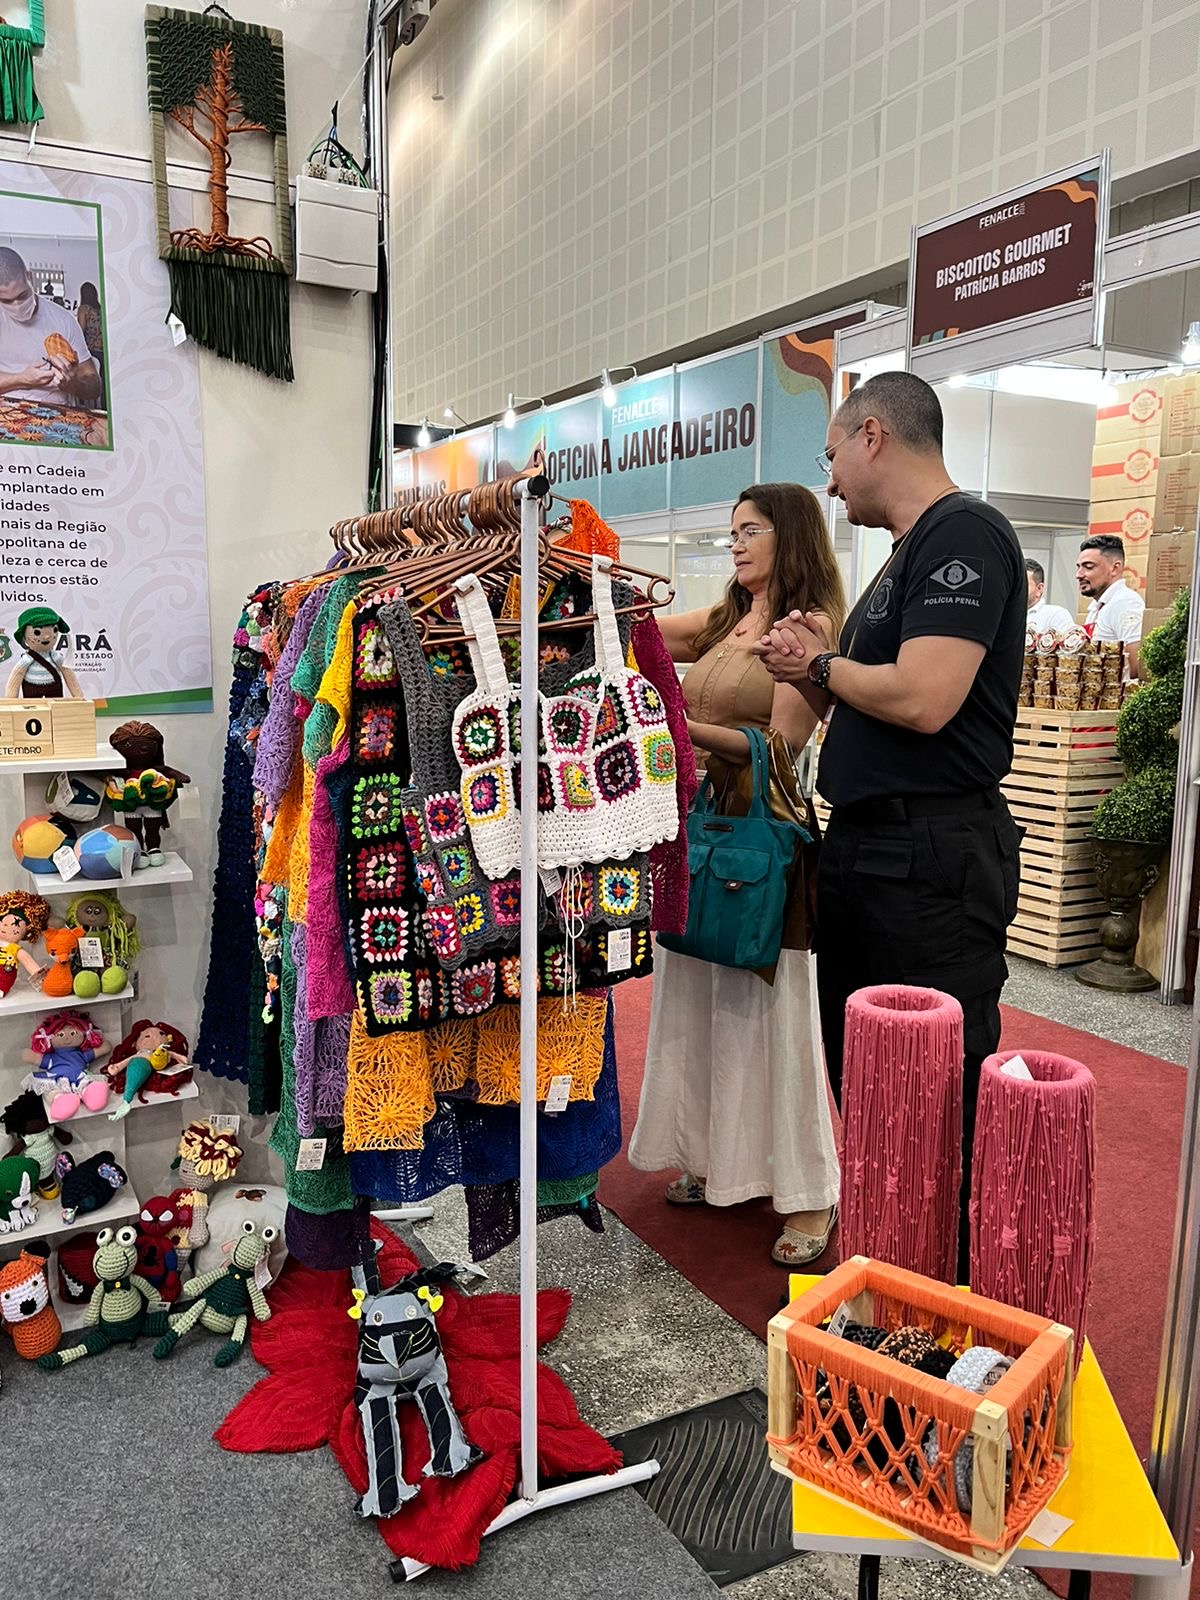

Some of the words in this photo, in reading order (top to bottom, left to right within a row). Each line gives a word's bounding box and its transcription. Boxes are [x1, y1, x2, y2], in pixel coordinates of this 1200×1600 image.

[979, 203, 1020, 229] FENACCE
[936, 248, 1001, 289] BISCOITOS
[1004, 222, 1072, 265] GOURMET
[954, 273, 999, 301] PATRÍCIA
[1001, 257, 1046, 286] BARROS
[547, 438, 612, 486] OFICINA
[618, 402, 756, 472] JANGADEIRO
[8, 465, 32, 474] em
[36, 464, 86, 478] Cadeia
[82, 487, 105, 497] em
[1, 499, 50, 512] idades
[1, 518, 31, 530] nais
[35, 520, 53, 531] da
[57, 521, 107, 534] Região
[69, 539, 87, 550] de
[35, 557, 44, 567] e
[47, 558, 86, 568] cerca
[90, 557, 108, 568] de
[60, 574, 99, 586] estão
[923, 596, 954, 606] POLÍCIA
[954, 596, 980, 607] PENAL
[55, 628, 112, 651] ARÁ
